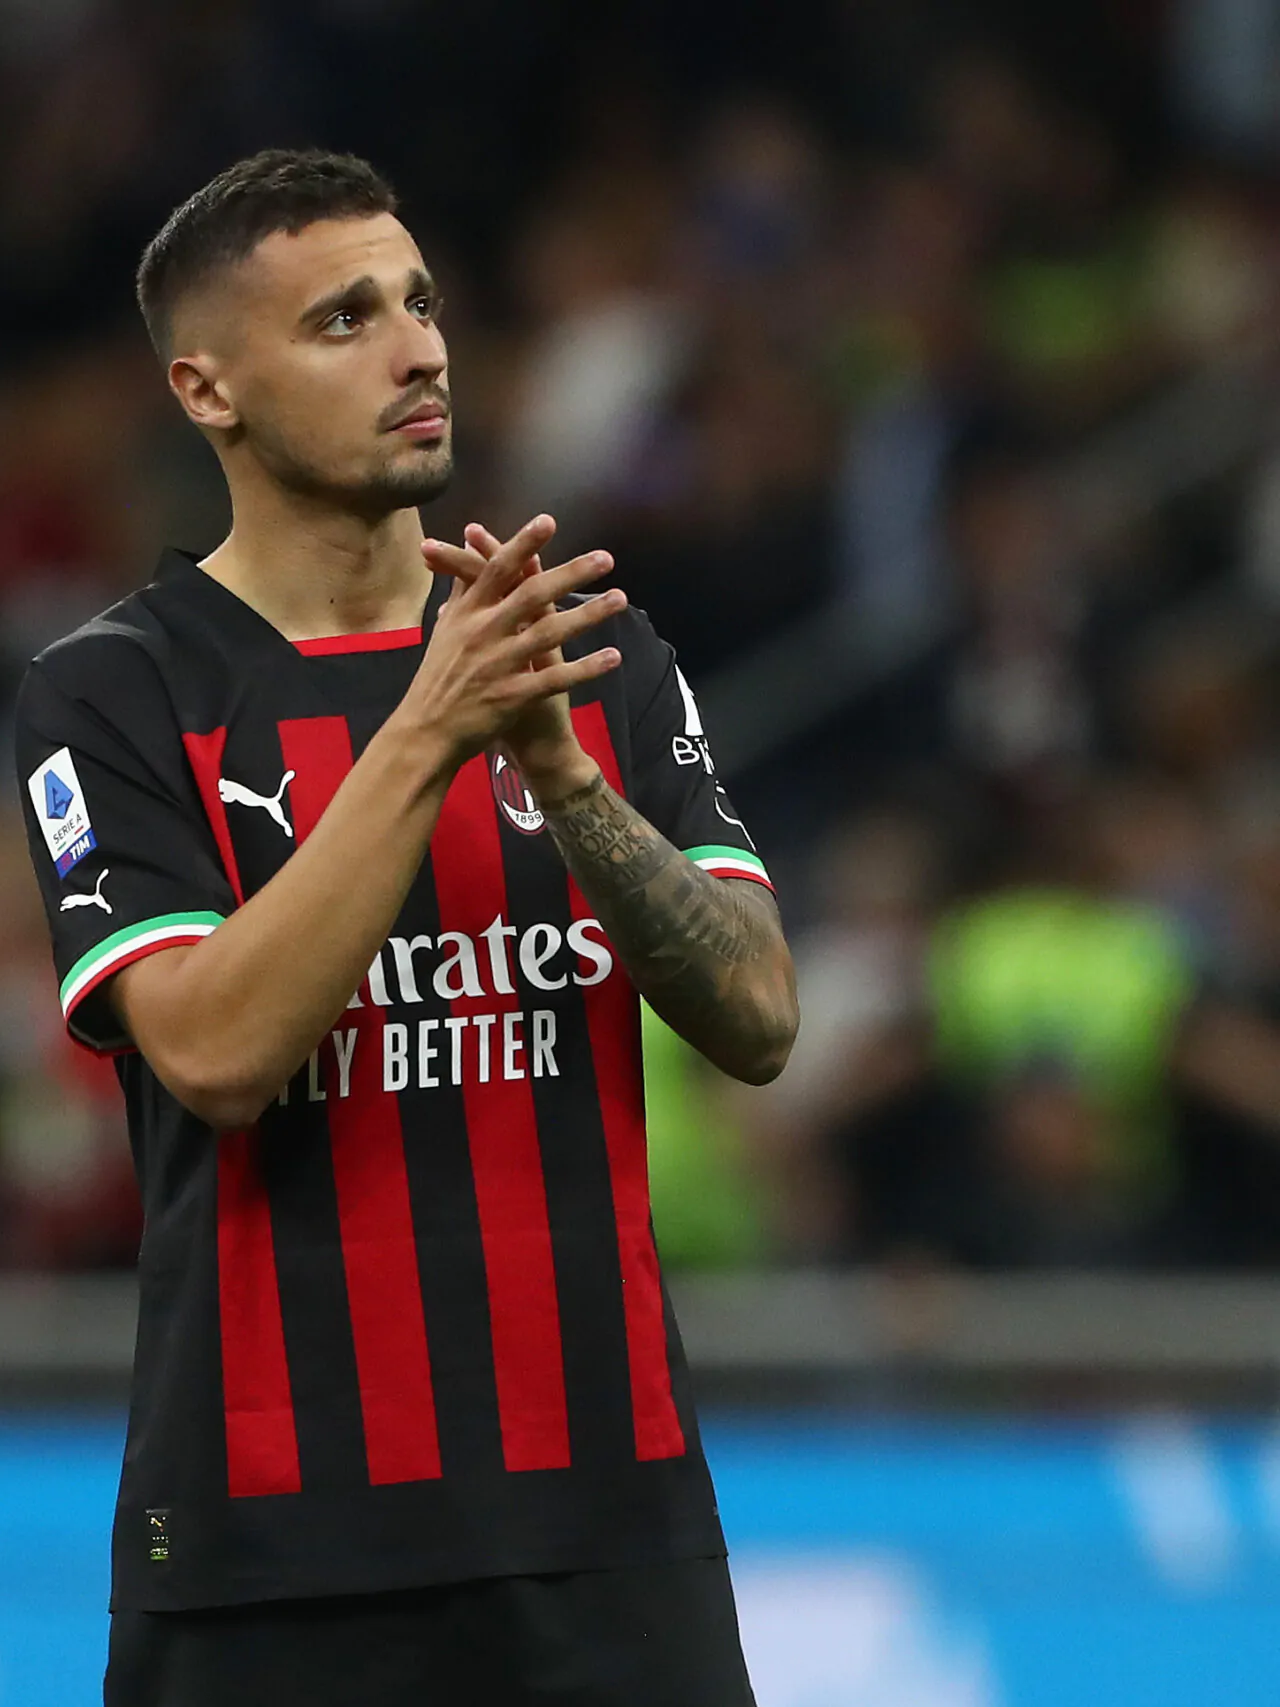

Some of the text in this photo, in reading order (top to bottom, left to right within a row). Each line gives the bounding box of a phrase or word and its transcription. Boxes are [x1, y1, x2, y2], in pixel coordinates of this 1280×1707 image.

[53, 818, 76, 845] SERIE
[514, 813, 542, 824] 1899
[69, 835, 90, 860] TIM
[346, 912, 613, 1009] irates
[278, 1010, 560, 1106] LY BETTER
